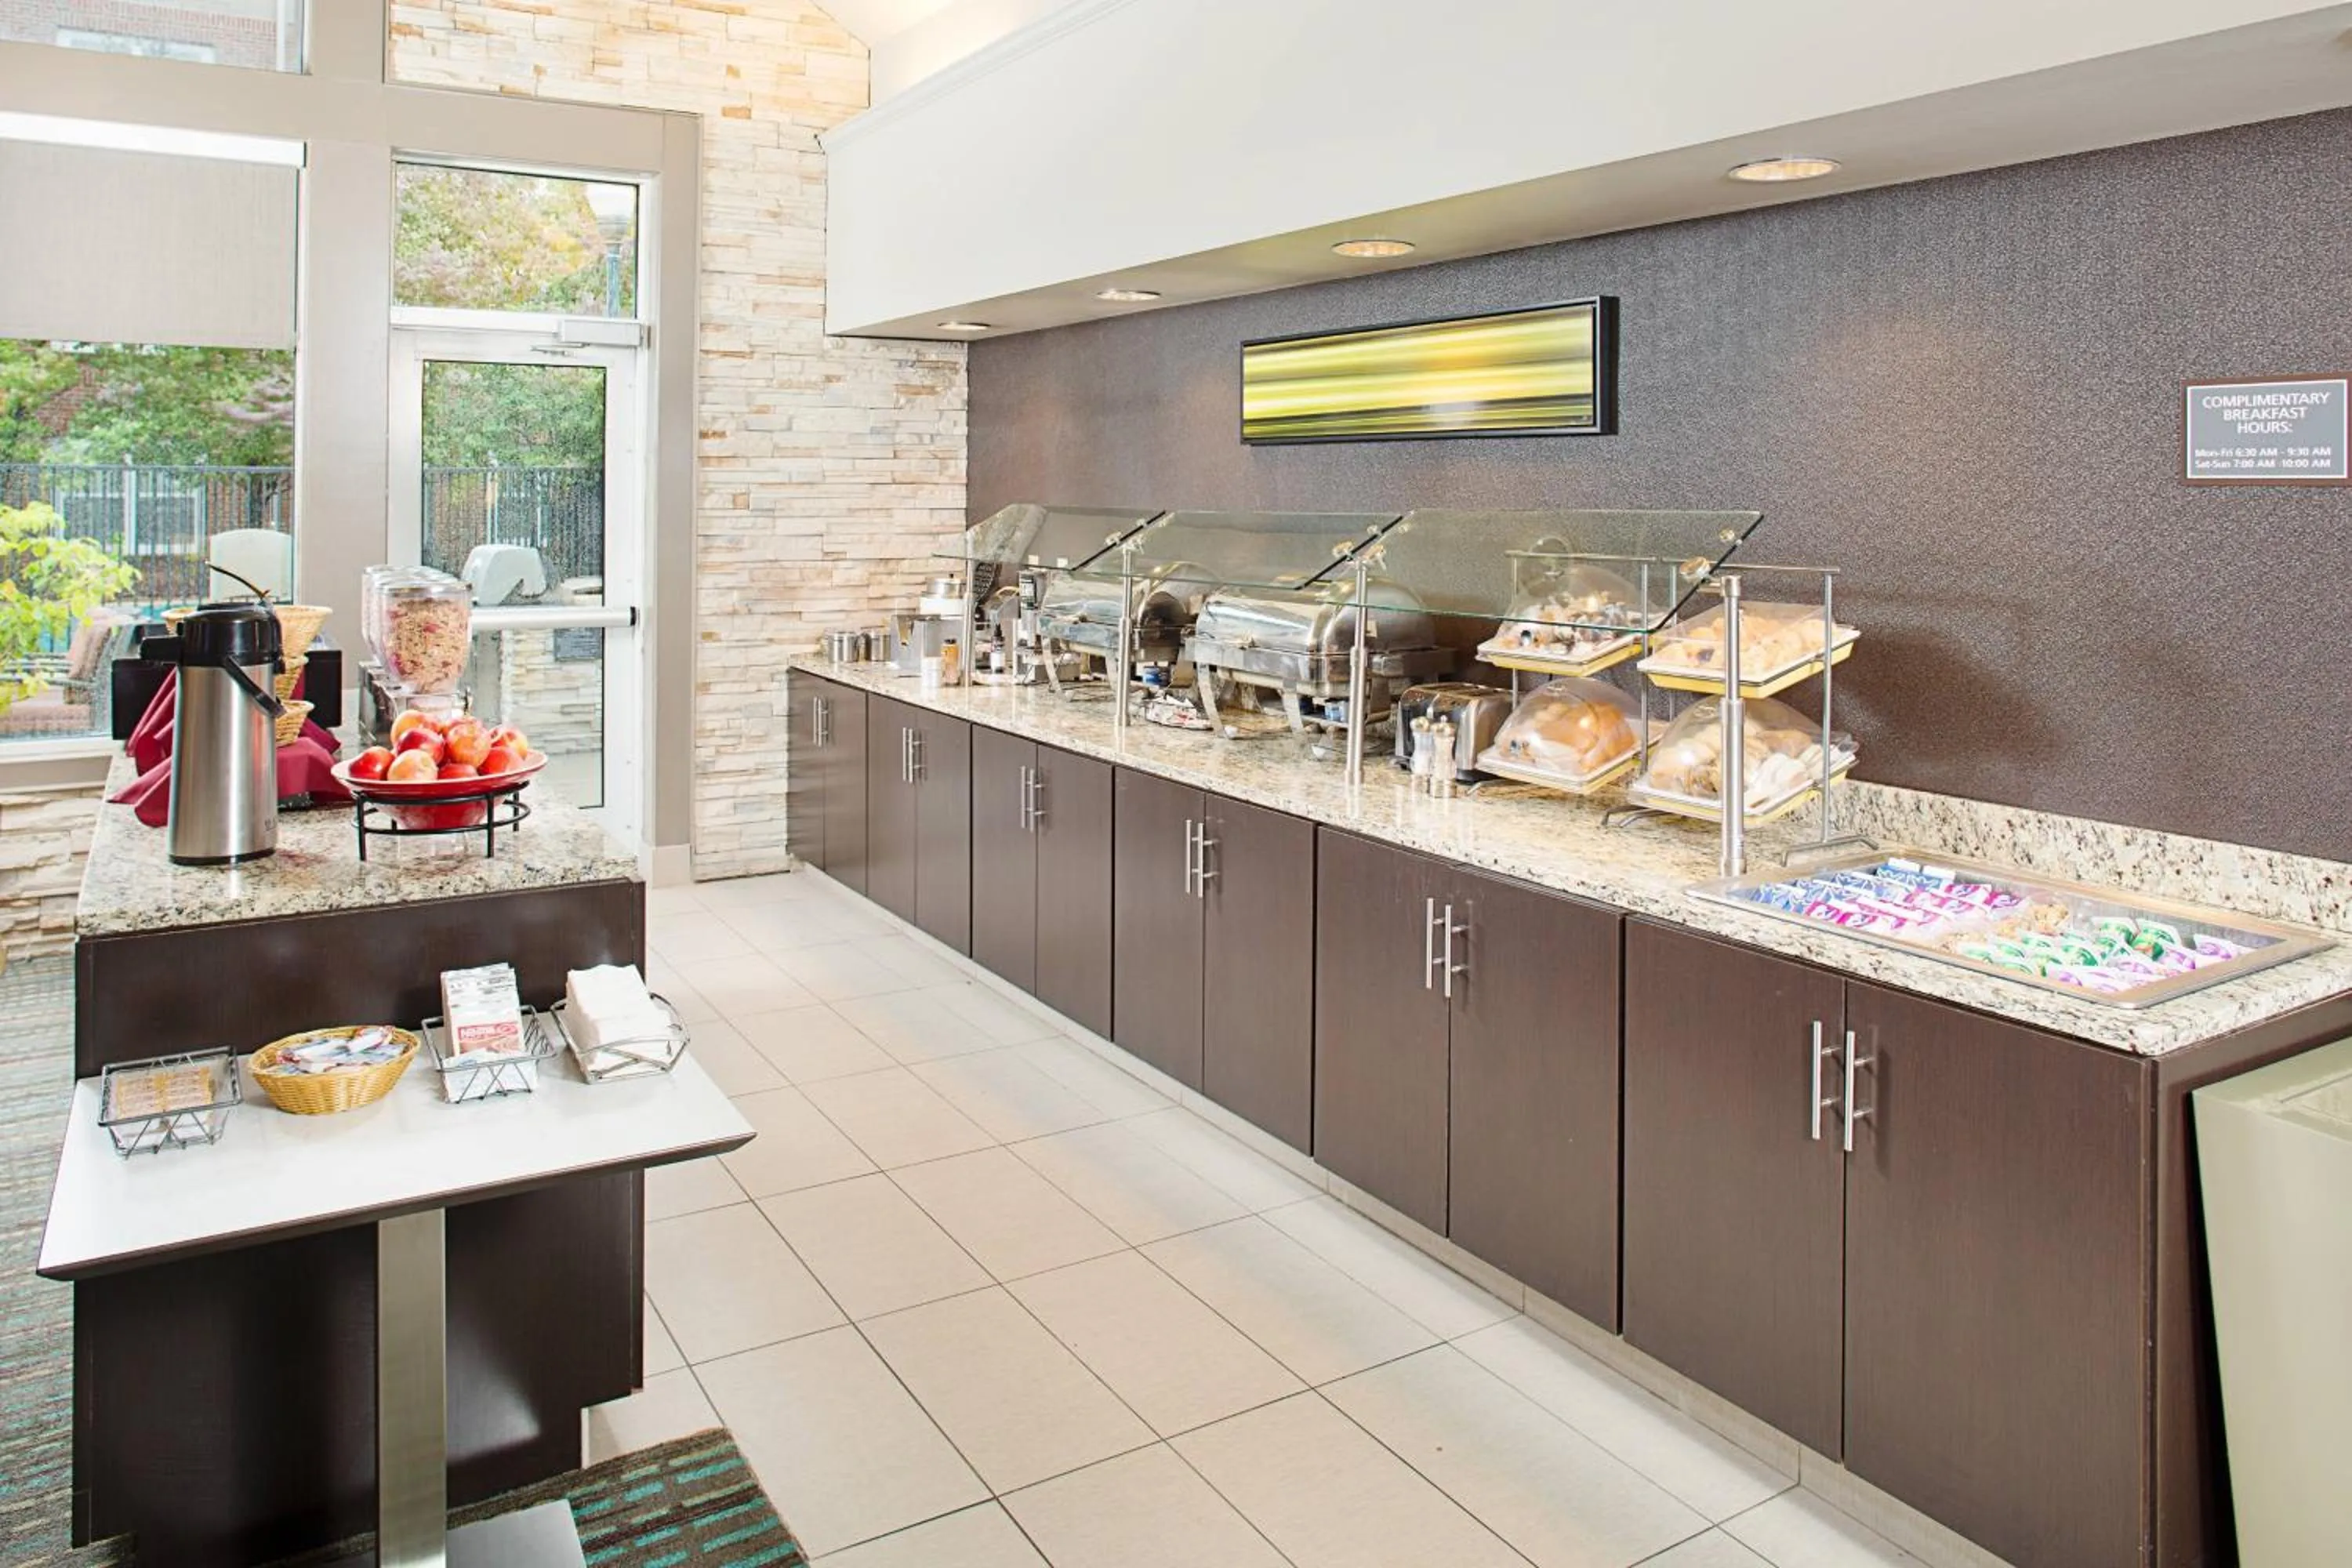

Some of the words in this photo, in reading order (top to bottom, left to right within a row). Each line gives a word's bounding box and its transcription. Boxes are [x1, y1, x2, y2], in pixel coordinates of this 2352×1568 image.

[2202, 392, 2331, 408] COMPLIMENTARY
[2223, 407, 2308, 420] BREAKFAST
[2238, 421, 2293, 434] HOURS:
[2259, 448, 2278, 456] AM
[2312, 446, 2331, 456] AM
[2257, 459, 2276, 468] AM
[2311, 458, 2331, 468] AM
